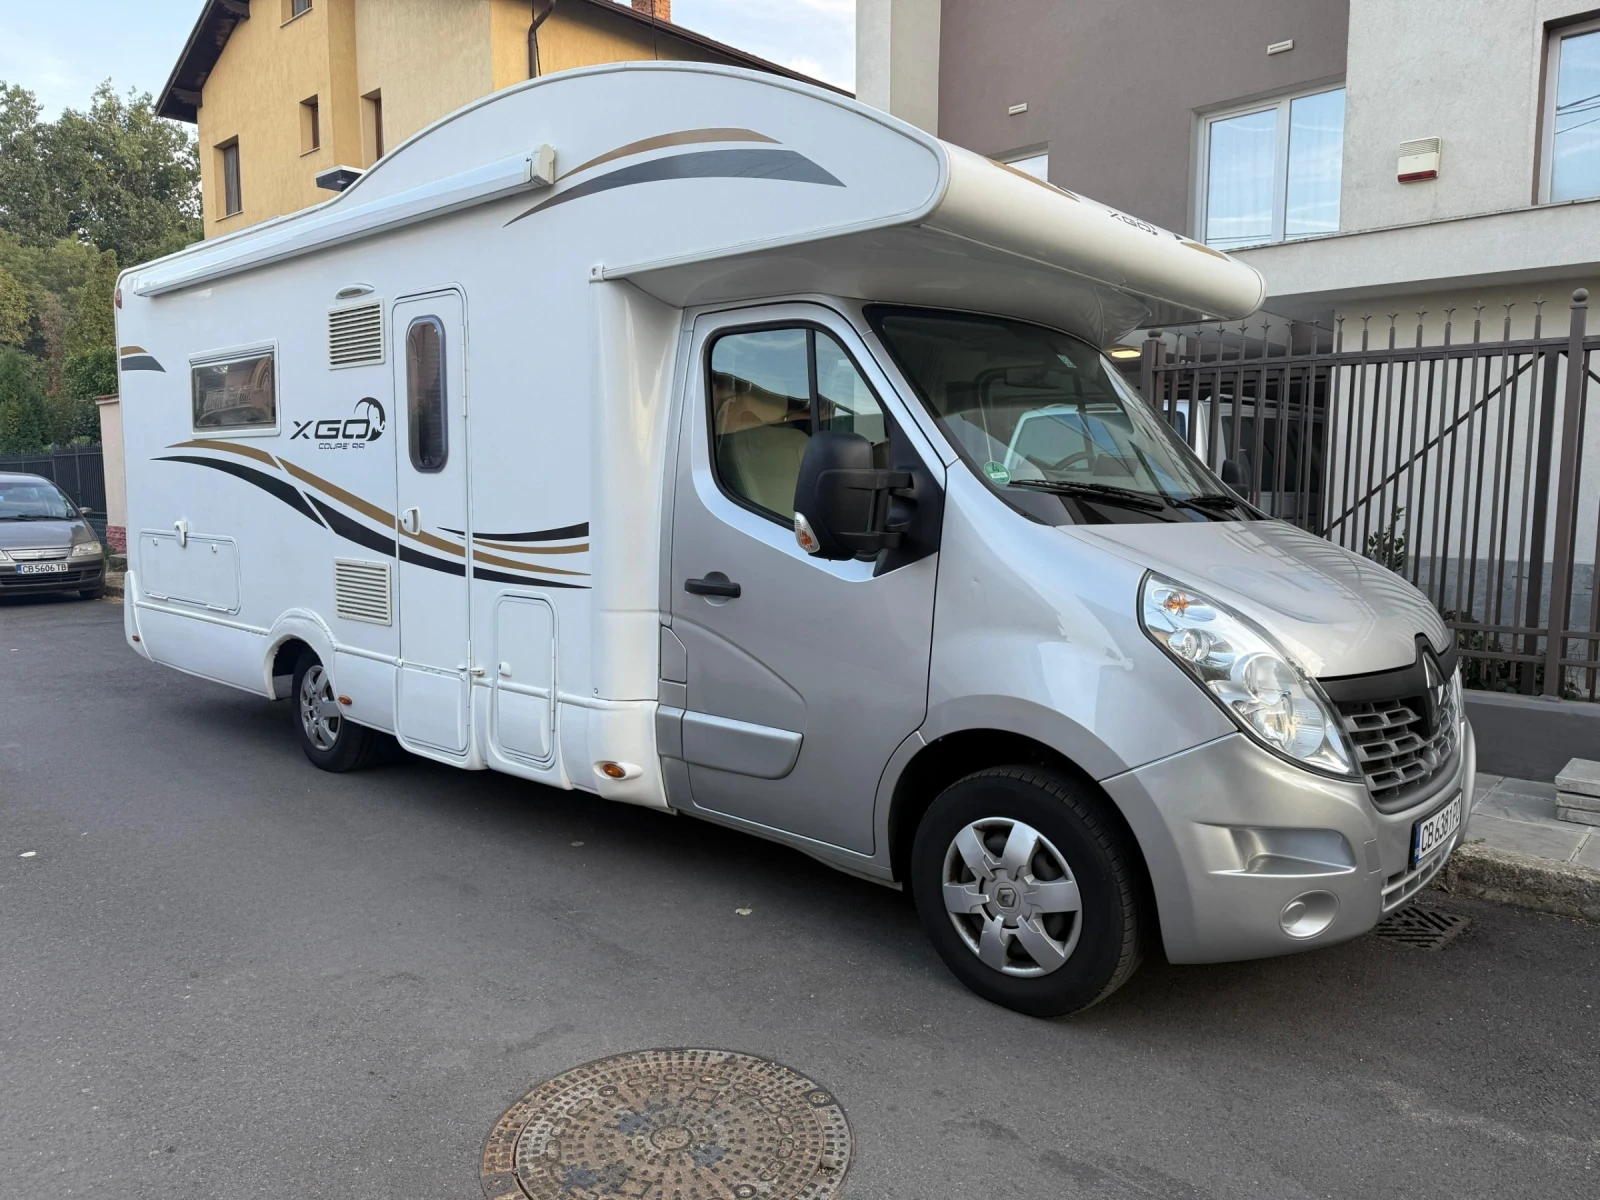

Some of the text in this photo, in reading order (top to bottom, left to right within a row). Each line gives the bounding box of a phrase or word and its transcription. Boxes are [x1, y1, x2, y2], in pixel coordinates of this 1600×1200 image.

[290, 419, 370, 440] XGO
[22, 565, 34, 574] CB
[1421, 821, 1434, 852] CB
